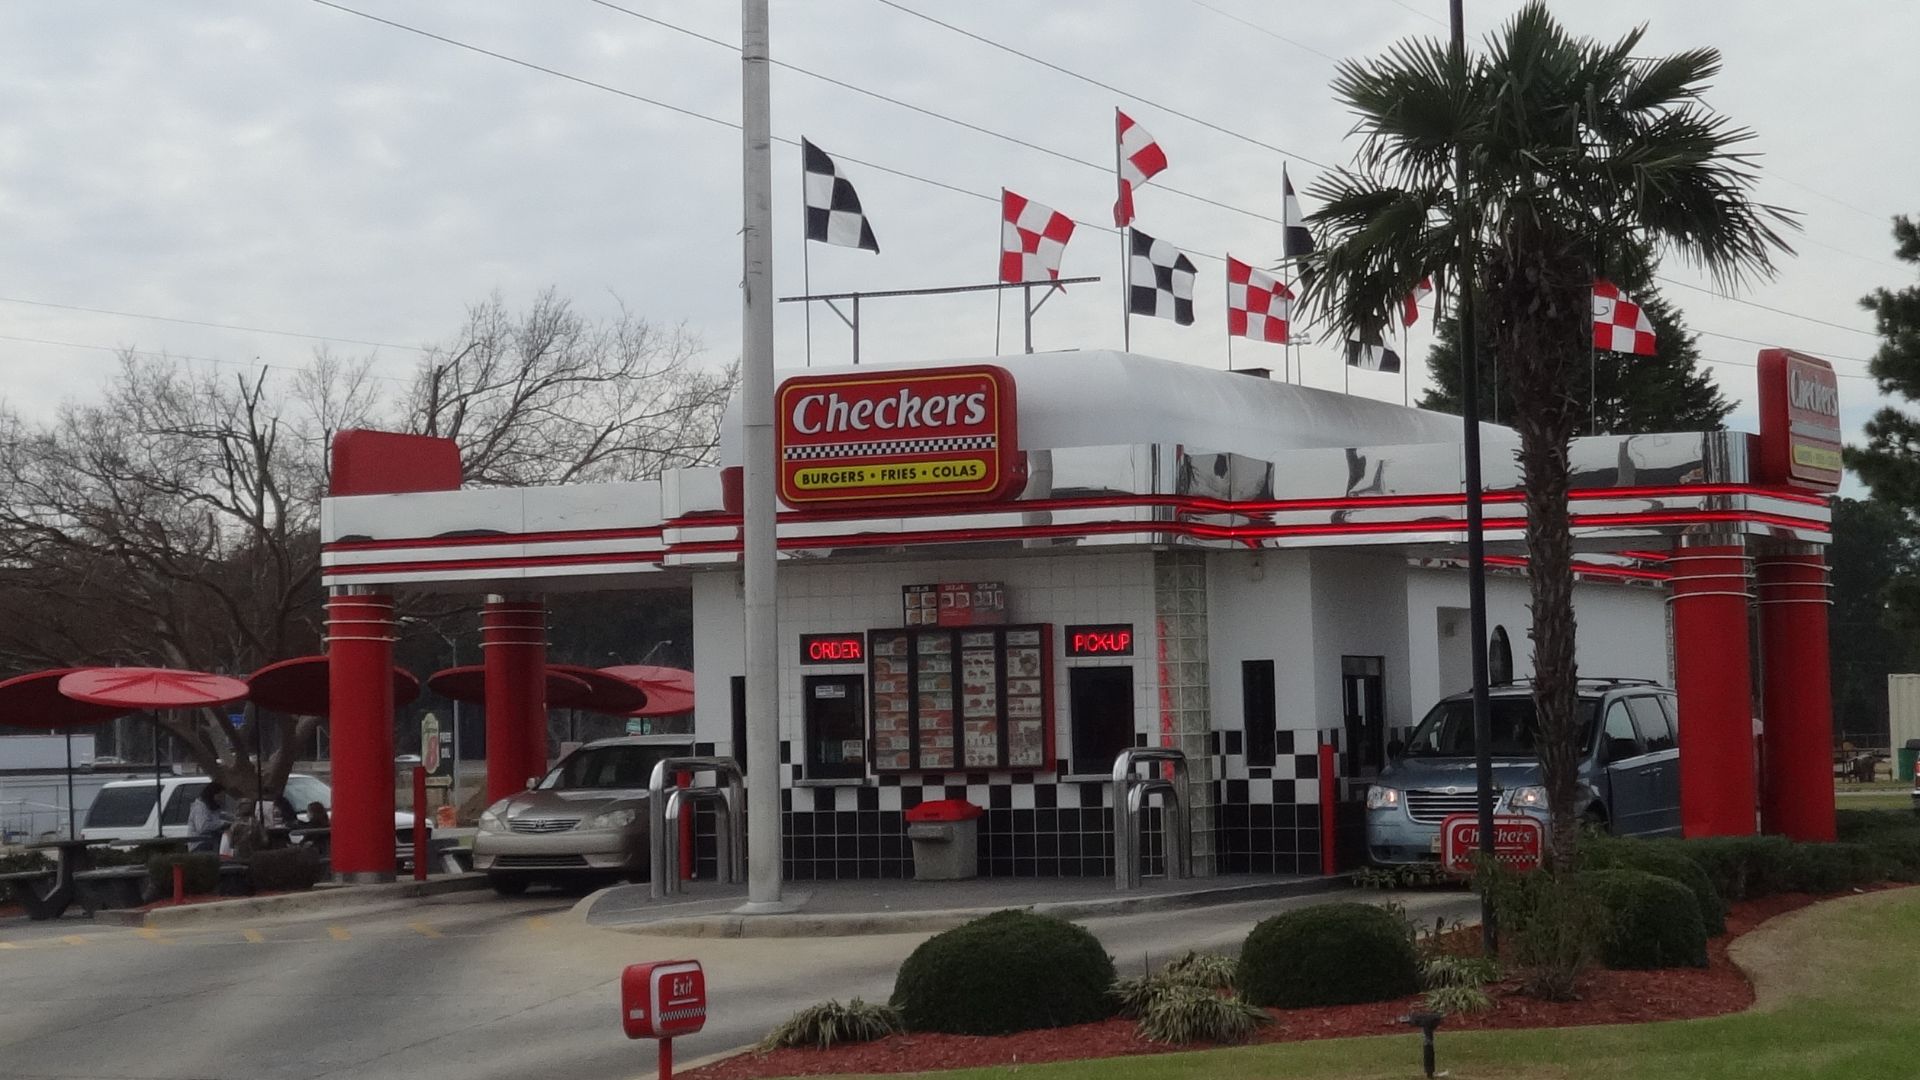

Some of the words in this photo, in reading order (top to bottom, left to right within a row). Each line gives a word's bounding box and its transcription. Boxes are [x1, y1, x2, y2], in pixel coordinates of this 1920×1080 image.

[792, 389, 986, 435] Checkers
[802, 471, 865, 485] BURGERS
[881, 468, 917, 481] FRIES
[932, 464, 978, 478] COLAS
[810, 641, 861, 660] ORDER
[1074, 632, 1130, 652] PICK-UP
[1458, 828, 1532, 844] Chkers
[673, 976, 693, 997] Exit
